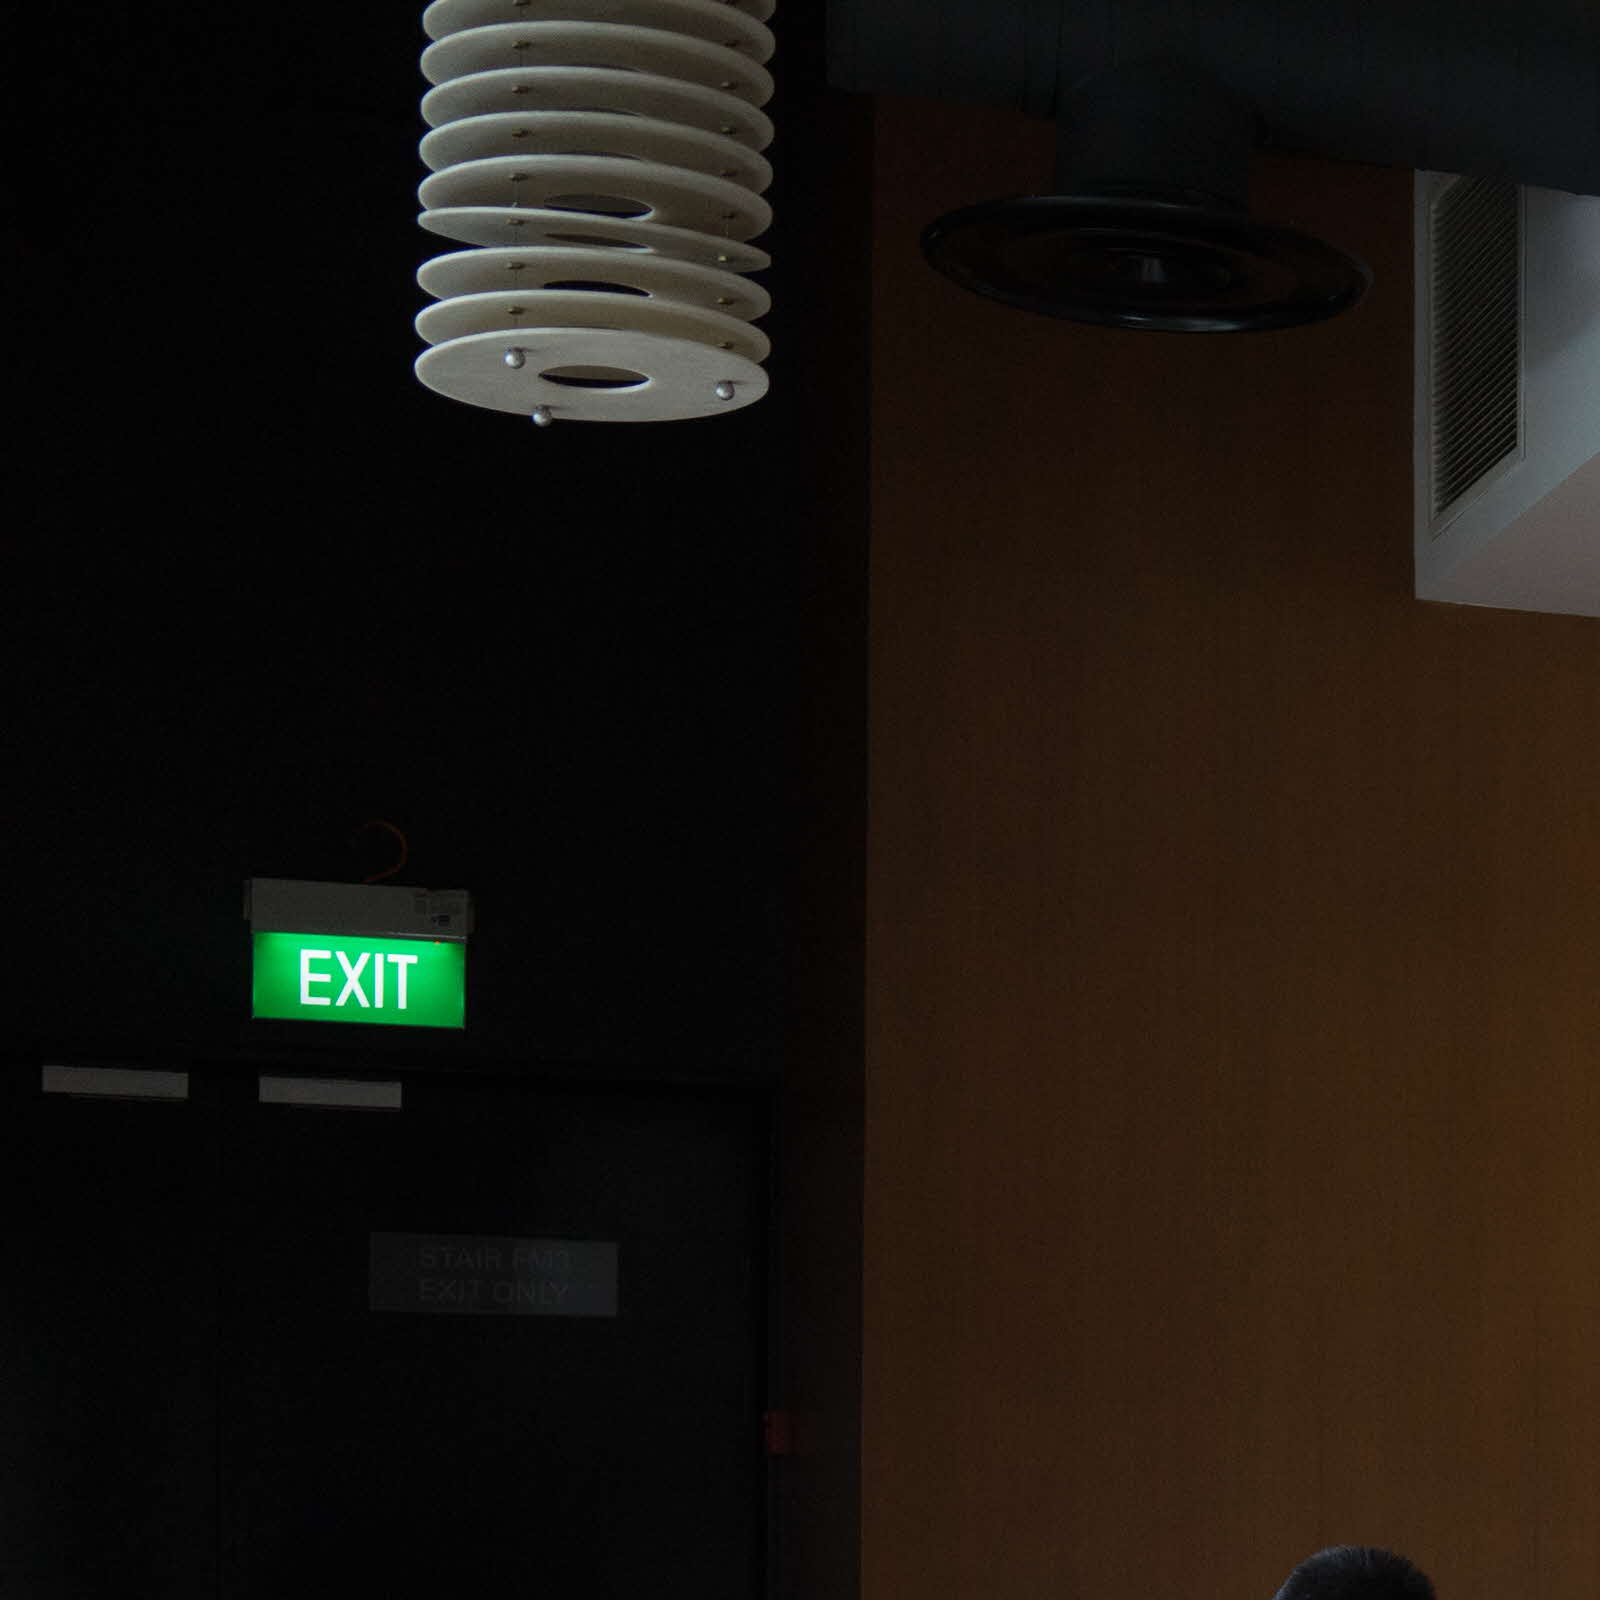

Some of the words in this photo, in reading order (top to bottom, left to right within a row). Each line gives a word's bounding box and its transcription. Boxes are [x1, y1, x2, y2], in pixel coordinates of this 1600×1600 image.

[299, 949, 418, 1010] EXIT
[418, 1247, 503, 1271] STAIR
[418, 1278, 483, 1303] EXIT
[492, 1281, 570, 1305] ONLY
